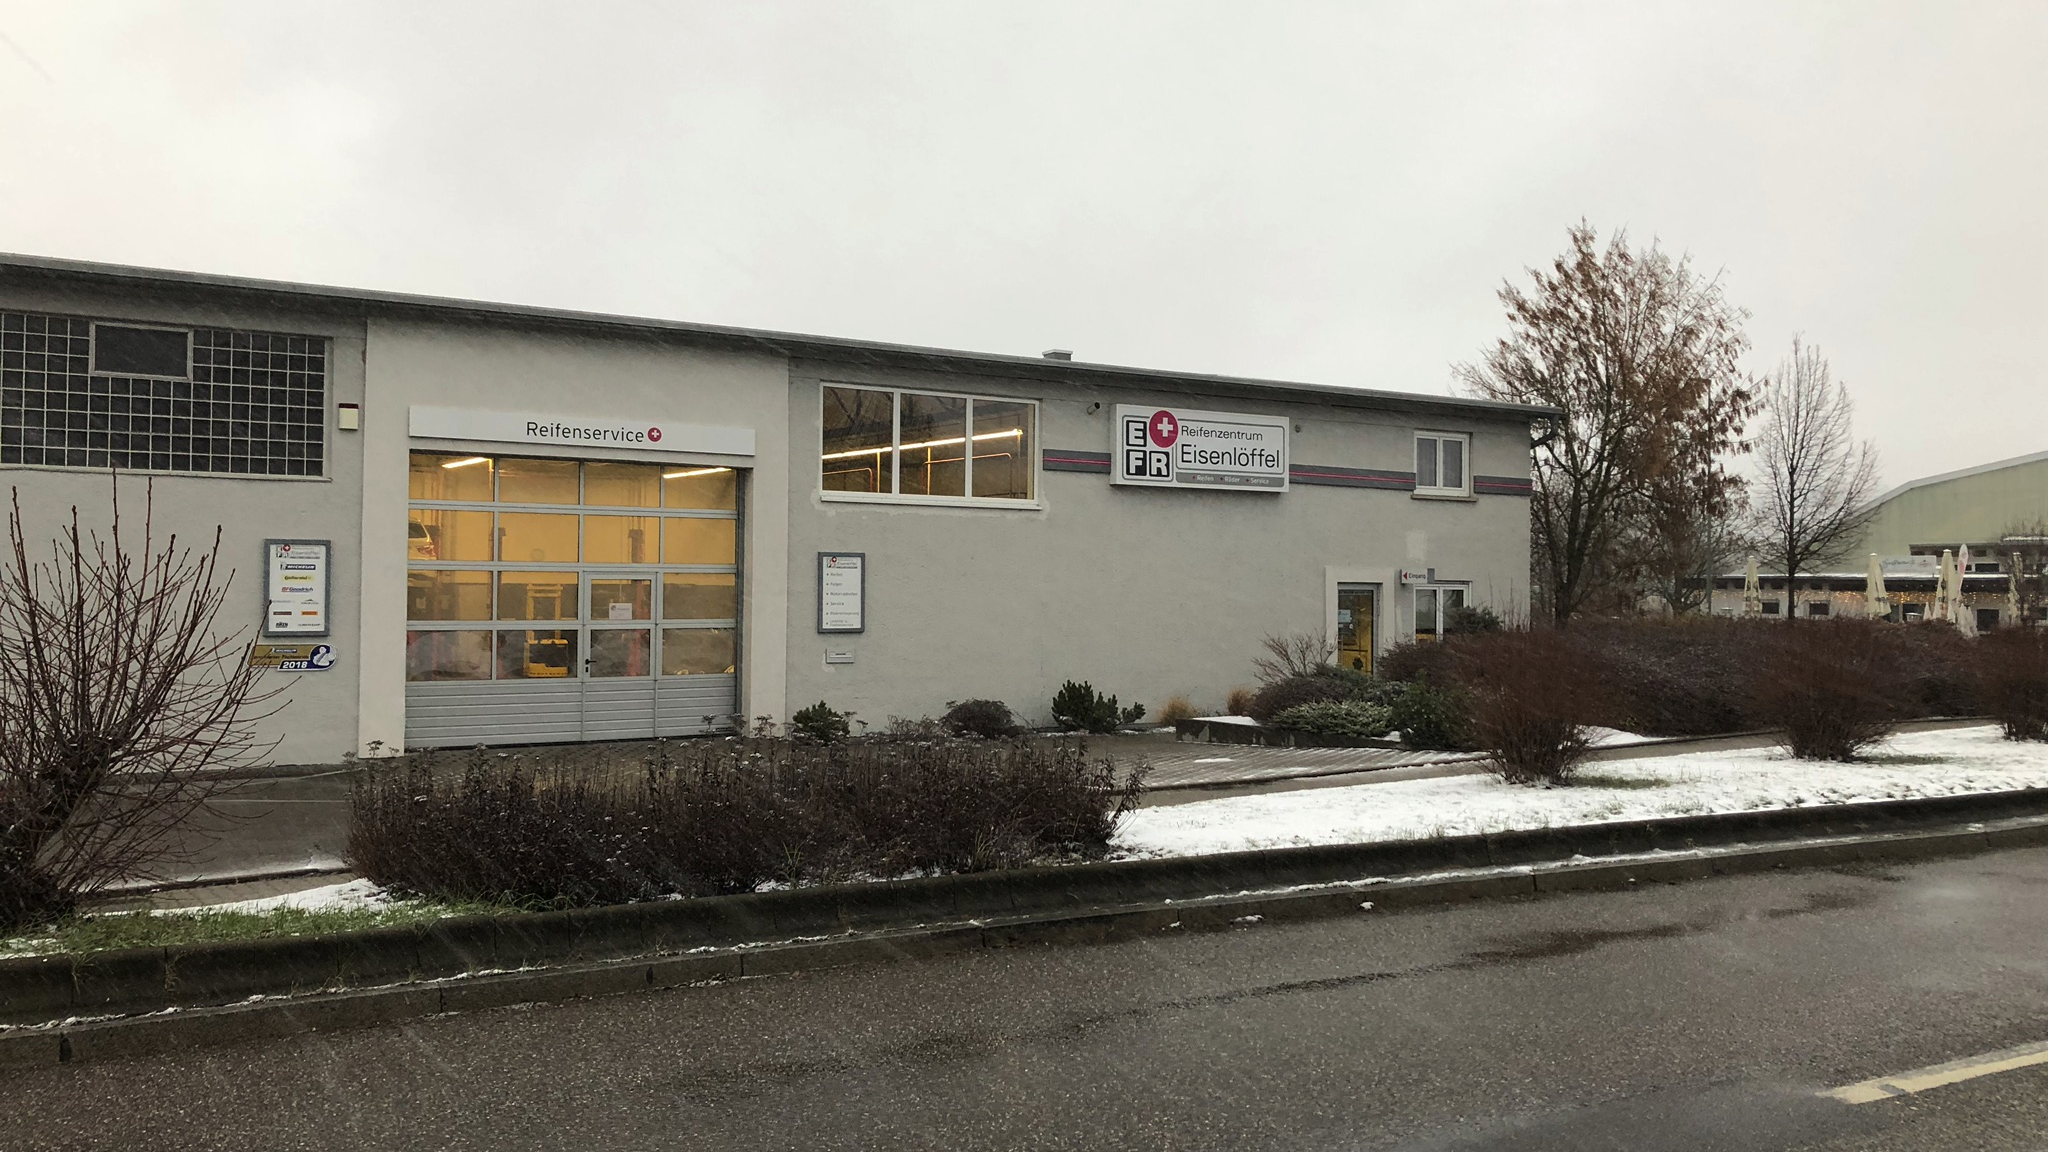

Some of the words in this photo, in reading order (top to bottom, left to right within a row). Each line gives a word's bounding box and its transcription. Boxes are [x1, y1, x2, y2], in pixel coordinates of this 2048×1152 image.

[526, 421, 644, 442] Reifenservice
[1181, 425, 1263, 441] Reifenzentrum
[1181, 444, 1280, 468] Eisenlöffel
[1196, 474, 1215, 482] Reifen
[1250, 477, 1270, 485] Service
[1408, 572, 1426, 580] Eingang
[282, 661, 308, 669] 2018
